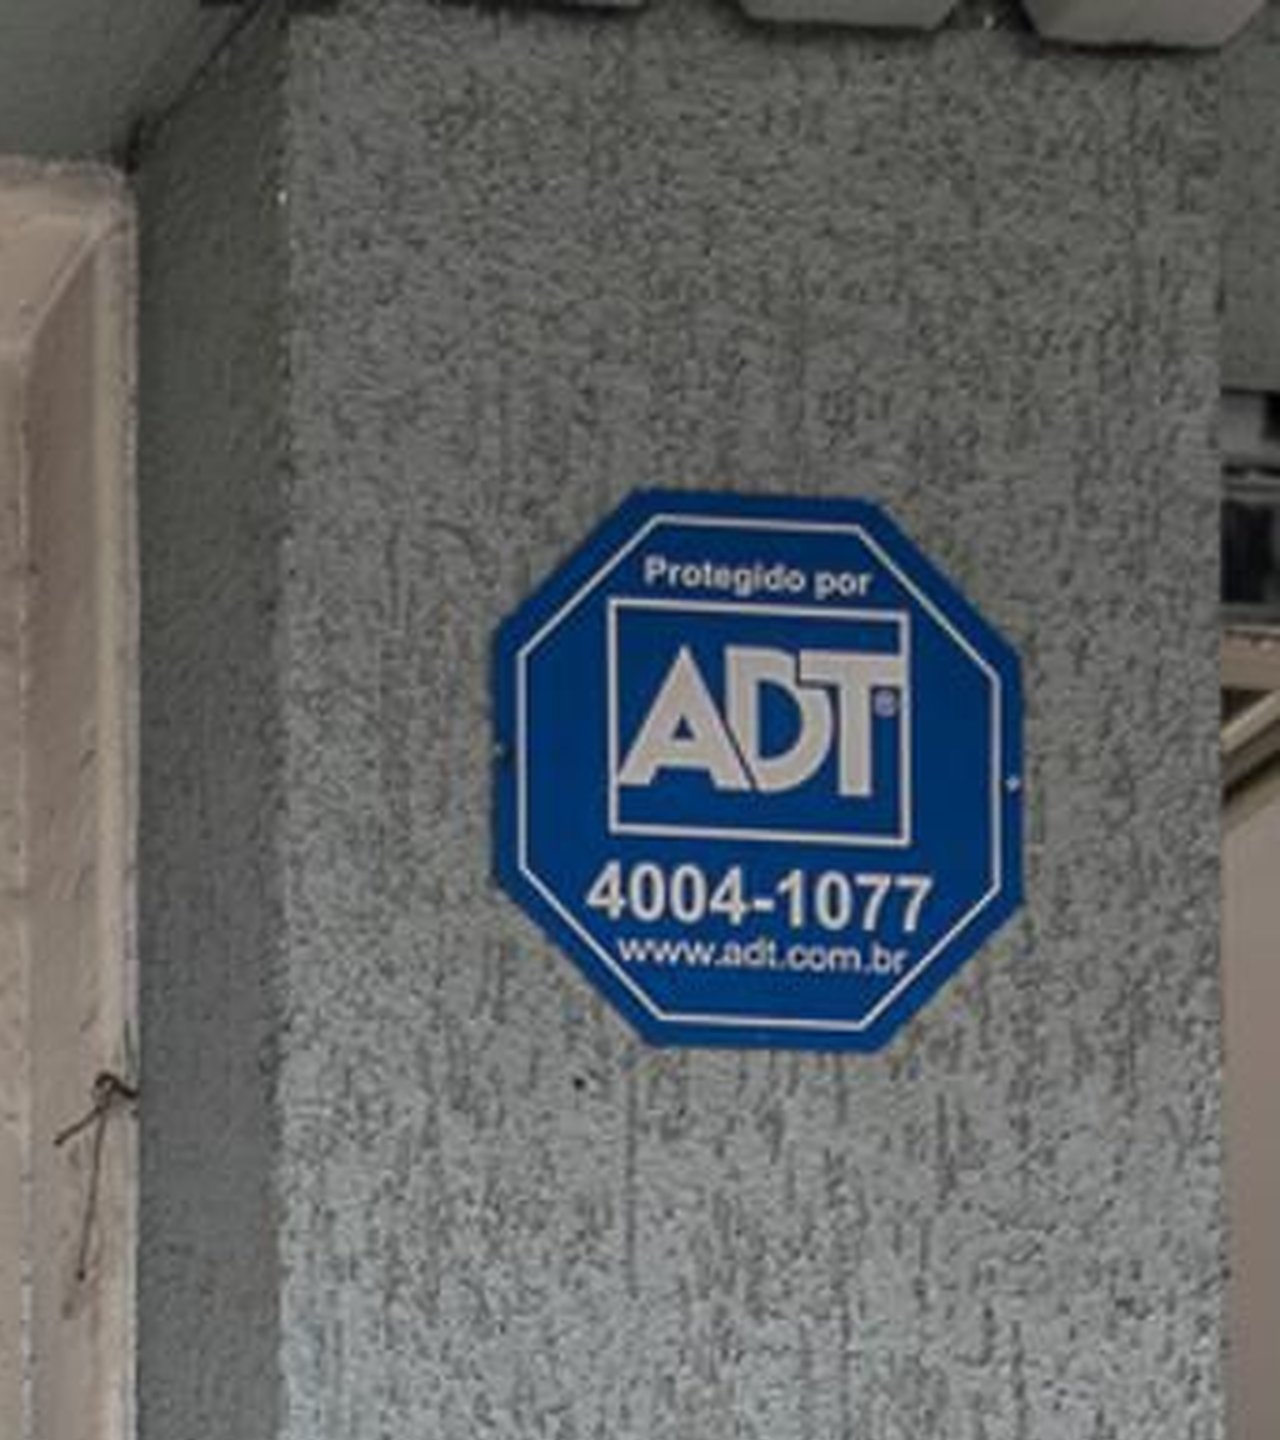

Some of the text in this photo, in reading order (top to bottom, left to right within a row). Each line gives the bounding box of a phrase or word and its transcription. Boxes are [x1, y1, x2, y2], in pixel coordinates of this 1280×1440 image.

[643, 555, 873, 599] Protegido por
[618, 644, 906, 798] ADT
[585, 860, 934, 933] 4004-1077
[618, 936, 908, 976] www.adt.com.br
